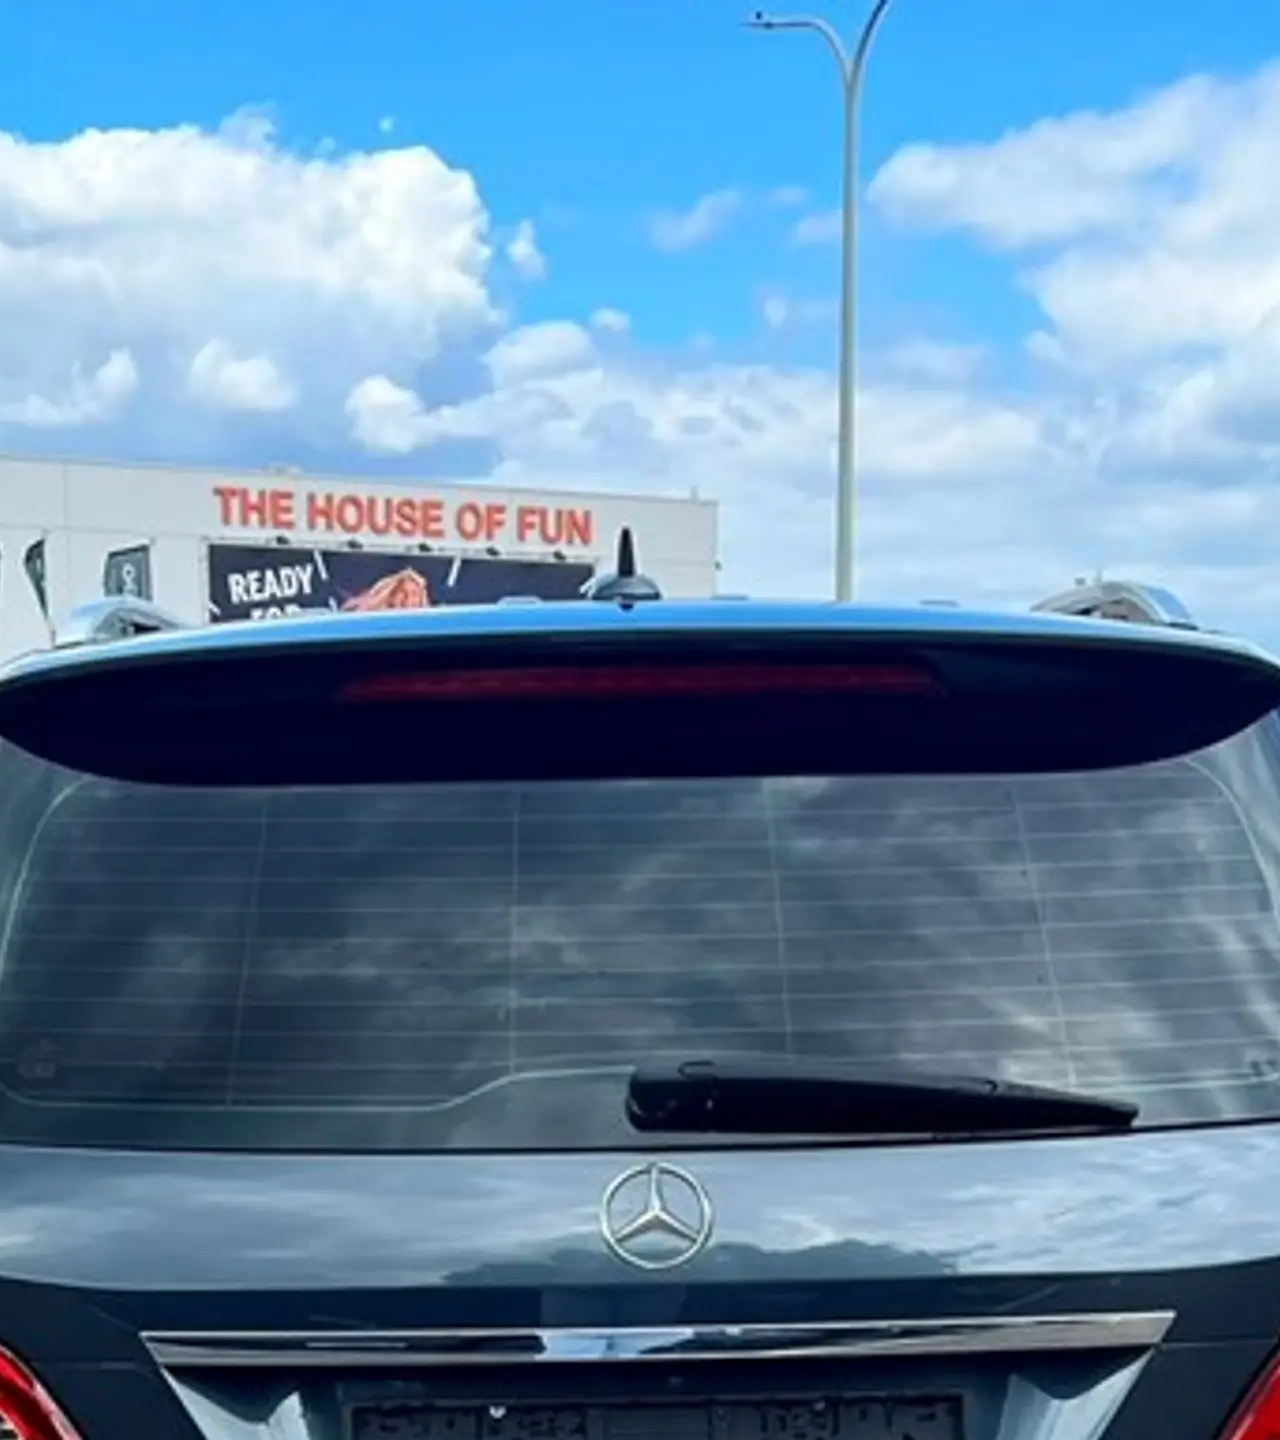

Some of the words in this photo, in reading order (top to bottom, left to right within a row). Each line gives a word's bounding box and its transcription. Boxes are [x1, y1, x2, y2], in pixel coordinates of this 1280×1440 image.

[212, 487, 295, 528] THE
[306, 493, 446, 539] HOUSE
[455, 502, 507, 542] OF
[516, 505, 593, 546] FUN
[227, 562, 315, 605] READY
